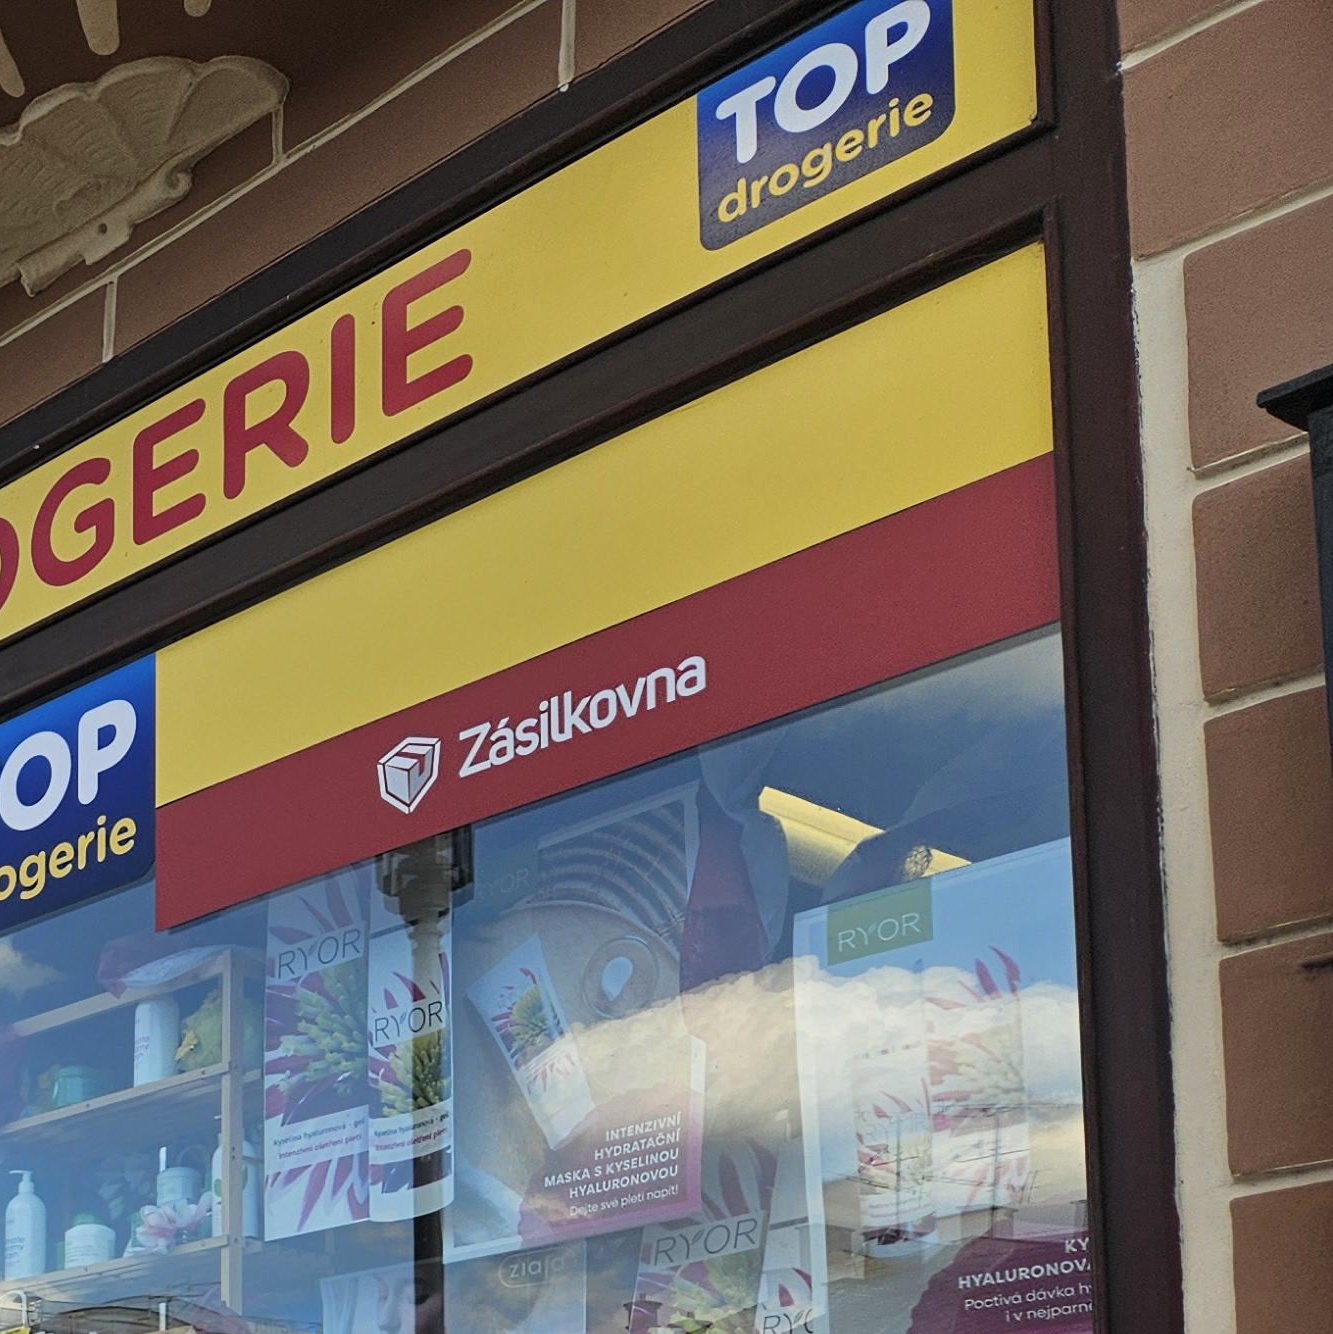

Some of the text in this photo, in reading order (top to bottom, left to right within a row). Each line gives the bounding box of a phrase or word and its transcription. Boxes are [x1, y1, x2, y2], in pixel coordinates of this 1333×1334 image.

[716, 0, 931, 166] TOP
[717, 91, 933, 224] drogerie
[459, 654, 707, 780] Zásilkovna
[838, 912, 921, 952] RYOR
[277, 928, 361, 979] RYOR
[374, 1000, 443, 1042] RYOR
[594, 1127, 681, 1161] HYDRATAČNÍ
[605, 1111, 681, 1142] INTENZIVNÍ
[544, 1147, 679, 1188] MASKA S KYSELINOU
[568, 1164, 679, 1199] HYALURONOVOU
[654, 1217, 758, 1267] RYOR
[965, 1286, 1075, 1311] Poctivá dávka
